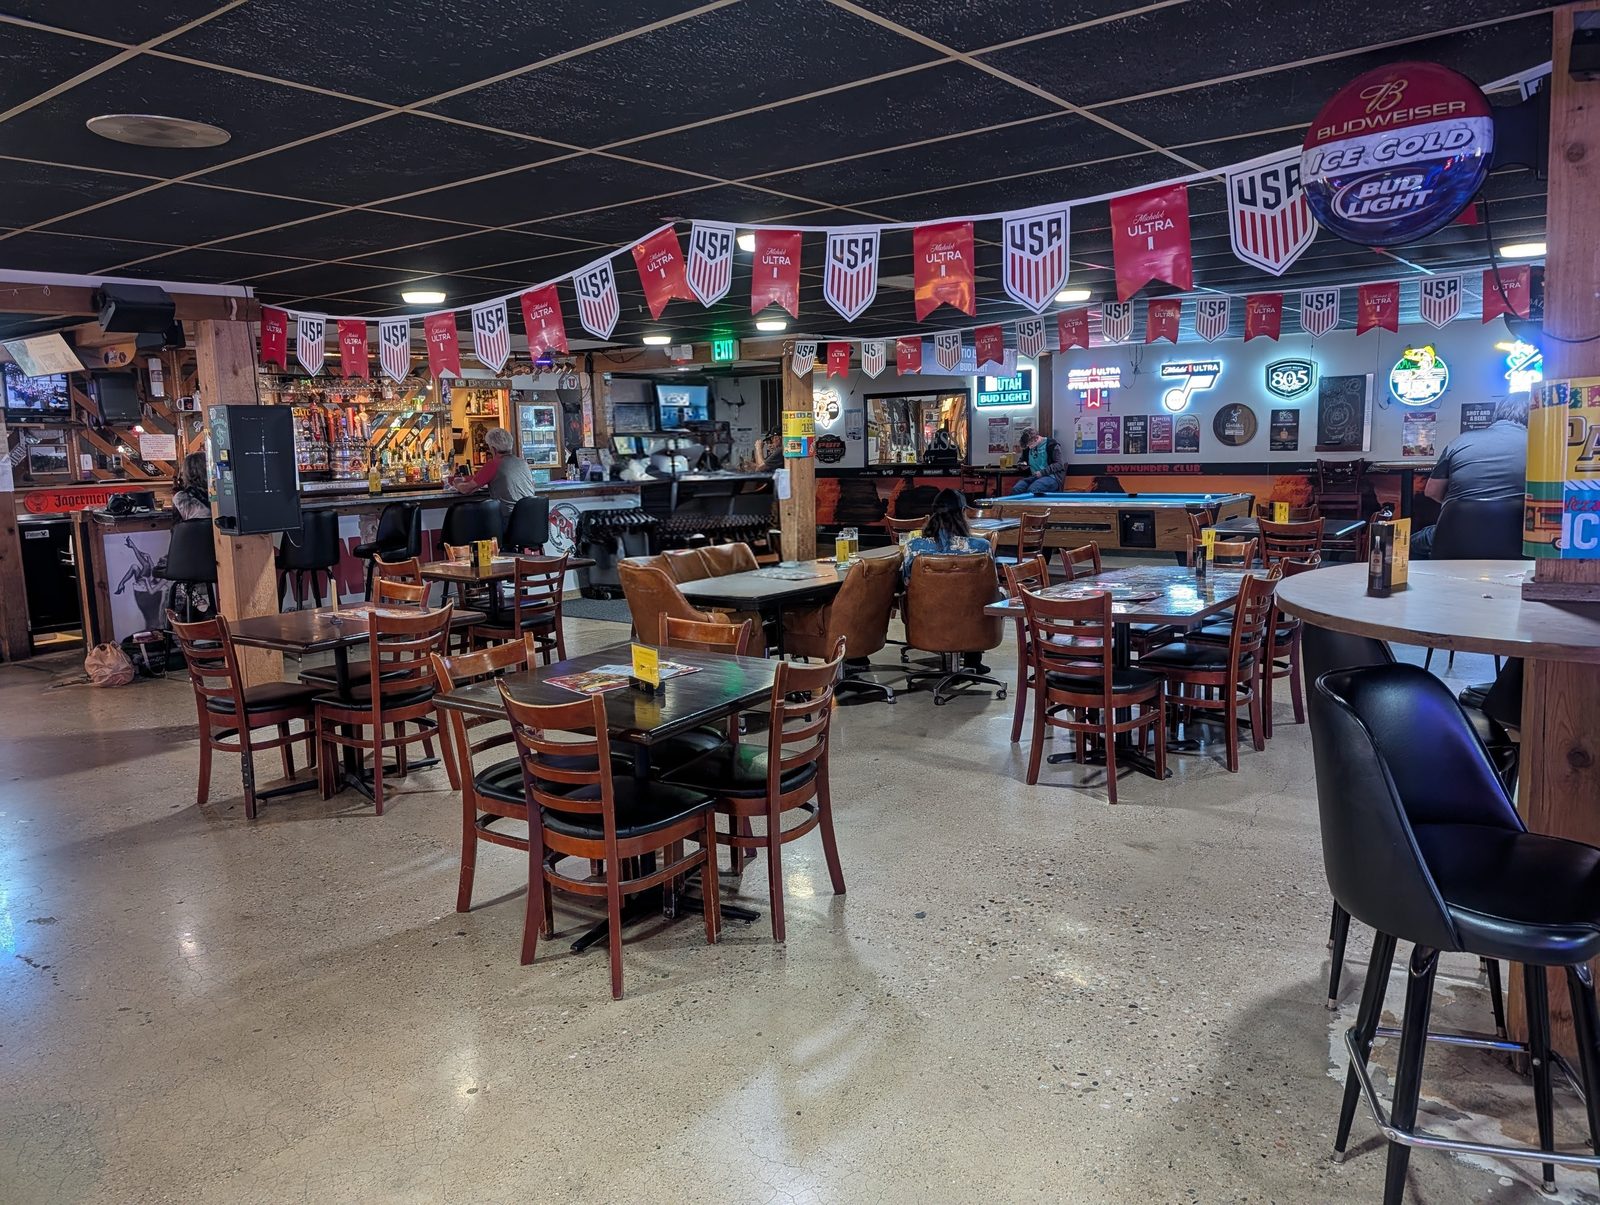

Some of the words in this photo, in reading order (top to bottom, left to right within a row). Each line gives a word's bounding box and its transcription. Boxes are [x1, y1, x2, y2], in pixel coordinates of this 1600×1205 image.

[1317, 100, 1466, 141] BUDWEISER
[1309, 145, 1366, 176] ICE
[1372, 128, 1476, 162] COLD
[1236, 163, 1303, 211] USA
[1357, 174, 1426, 199] BUD
[1346, 189, 1434, 218] LIGHT
[1127, 217, 1175, 237] ULTRA
[695, 230, 730, 261] USA
[1009, 216, 1062, 257] USA
[647, 253, 674, 272] ULTRA
[762, 255, 791, 266] ULTRA
[832, 238, 874, 270] USA
[925, 250, 963, 264] ULTRA
[578, 267, 611, 299] USA
[1423, 279, 1458, 300] USA
[1199, 300, 1226, 318] USA
[1305, 293, 1336, 311] USA
[1367, 297, 1392, 305] ULTRA
[530, 306, 554, 320] ULTRA
[1105, 302, 1130, 319] USA
[1254, 307, 1276, 315] ULTRA
[266, 325, 283, 334] ULTRA
[476, 307, 505, 334] USA
[1018, 320, 1042, 337] USA
[1064, 320, 1083, 328] ULTRA
[302, 320, 323, 343] USA
[383, 324, 407, 348] USA
[431, 332, 452, 342] ULTRA
[344, 337, 363, 346] ULTRA
[714, 340, 733, 360] EXIT
[937, 334, 959, 350] USA
[796, 345, 815, 358] USA
[1097, 366, 1121, 376] ULTRA
[1192, 363, 1219, 373] ULTRA
[997, 377, 1022, 391] UTAH
[1271, 369, 1309, 388] 805
[980, 393, 1001, 404] BUD
[1001, 391, 1029, 403] LIGHT
[1106, 464, 1170, 472] DOWNUNDER
[1173, 464, 1201, 472] CLUB
